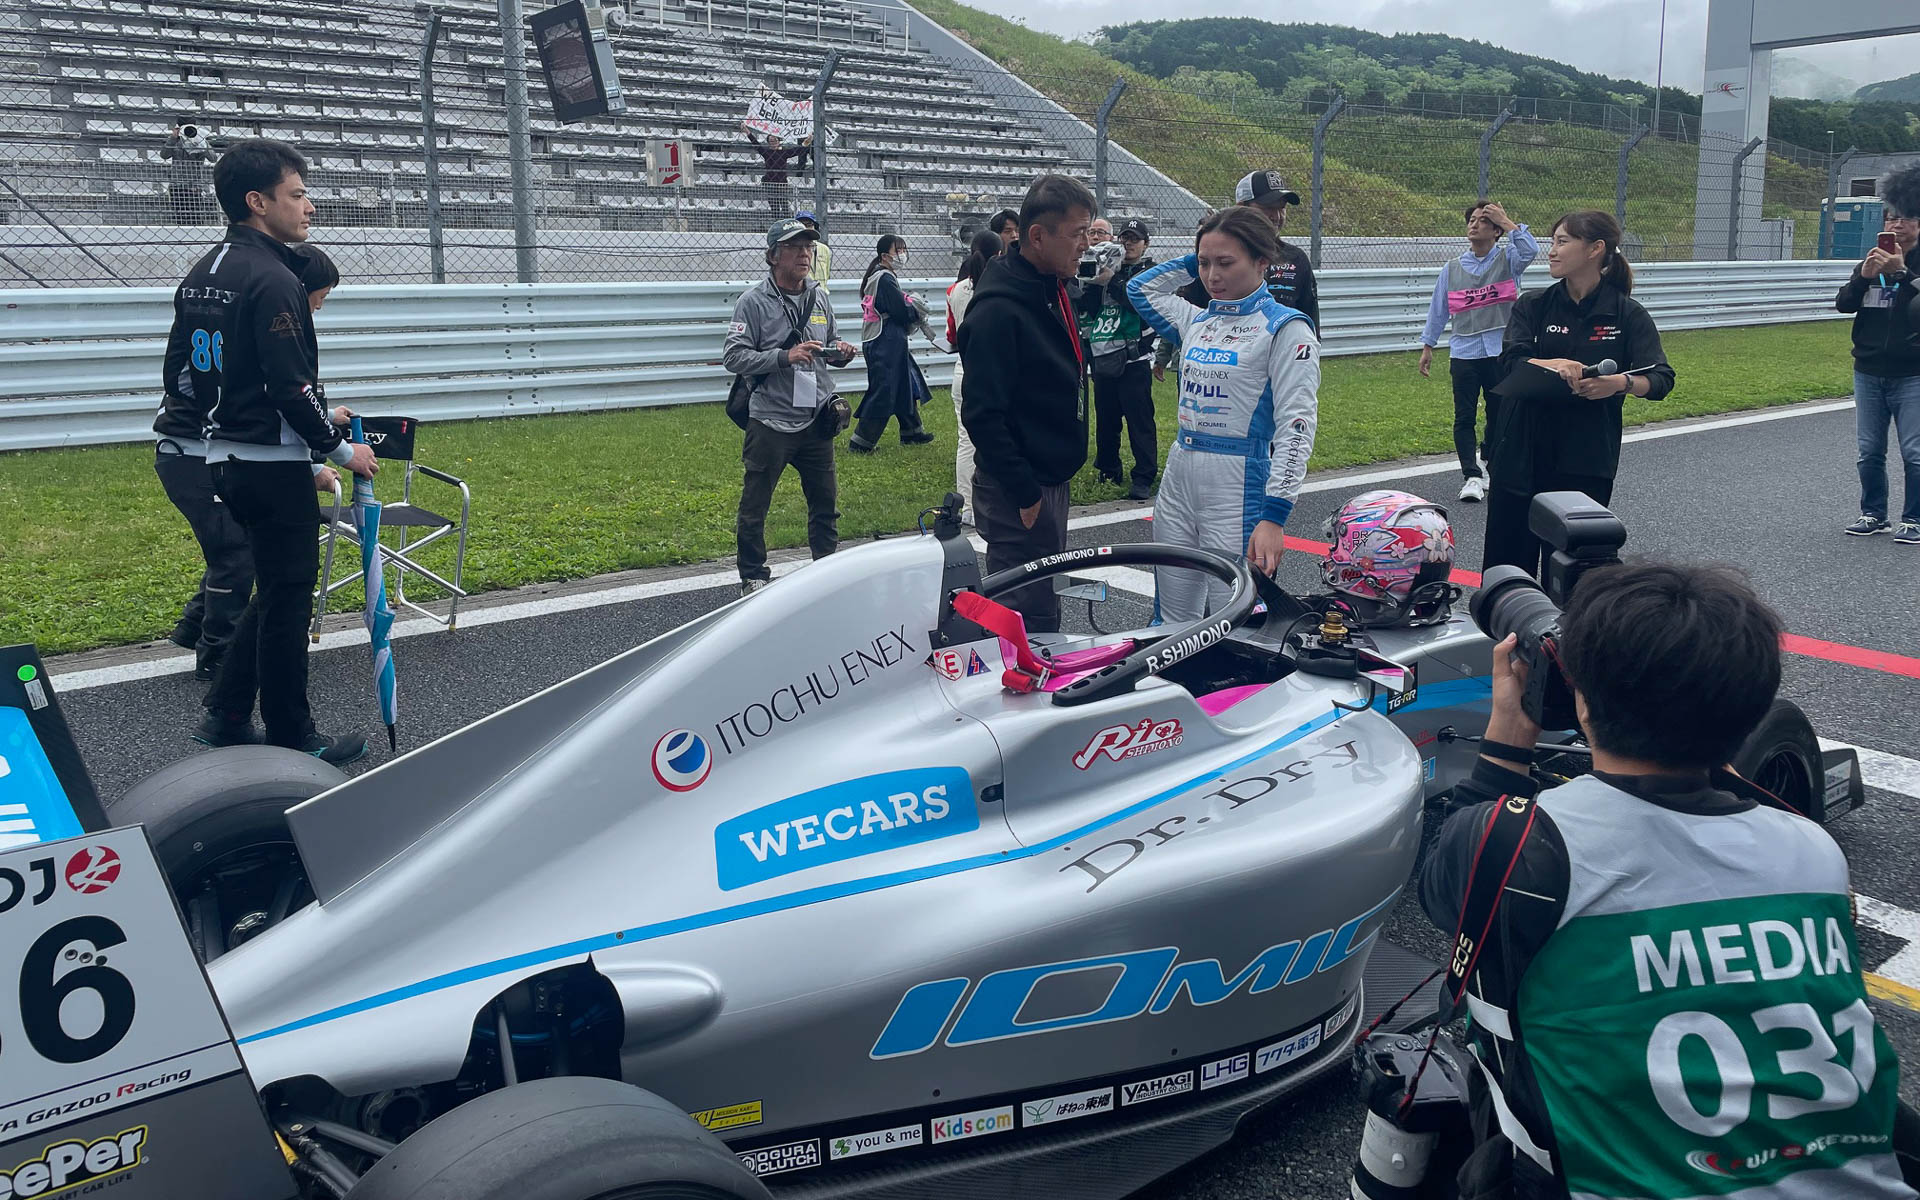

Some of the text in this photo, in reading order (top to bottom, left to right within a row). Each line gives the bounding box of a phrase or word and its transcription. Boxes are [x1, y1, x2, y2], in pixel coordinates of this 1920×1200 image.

[761, 86, 778, 107] We
[1465, 284, 1496, 295] MEDIA
[1023, 547, 1095, 573] 86 R.SHIMONO
[1145, 619, 1232, 674] R.SHIMONO
[943, 653, 959, 675] E
[715, 624, 916, 755] ITOCHU ENEX
[1125, 735, 1183, 760] SHIMONO
[738, 784, 950, 863] WECARS
[1452, 932, 1475, 979] EOS
[1630, 917, 1852, 993] MEDIA
[0, 915, 136, 1064] 6
[1202, 1055, 1248, 1081] LHG
[26, 1091, 112, 1125] GAZOO
[116, 1068, 192, 1098] Racing
[1123, 1072, 1192, 1103] YAHAGI
[757, 1142, 816, 1162] OGURA
[855, 1127, 921, 1151] you & me
[757, 1152, 817, 1173] CLUTCH
[82, 1181, 104, 1195] CAR
[108, 1172, 134, 1187] LIFE
